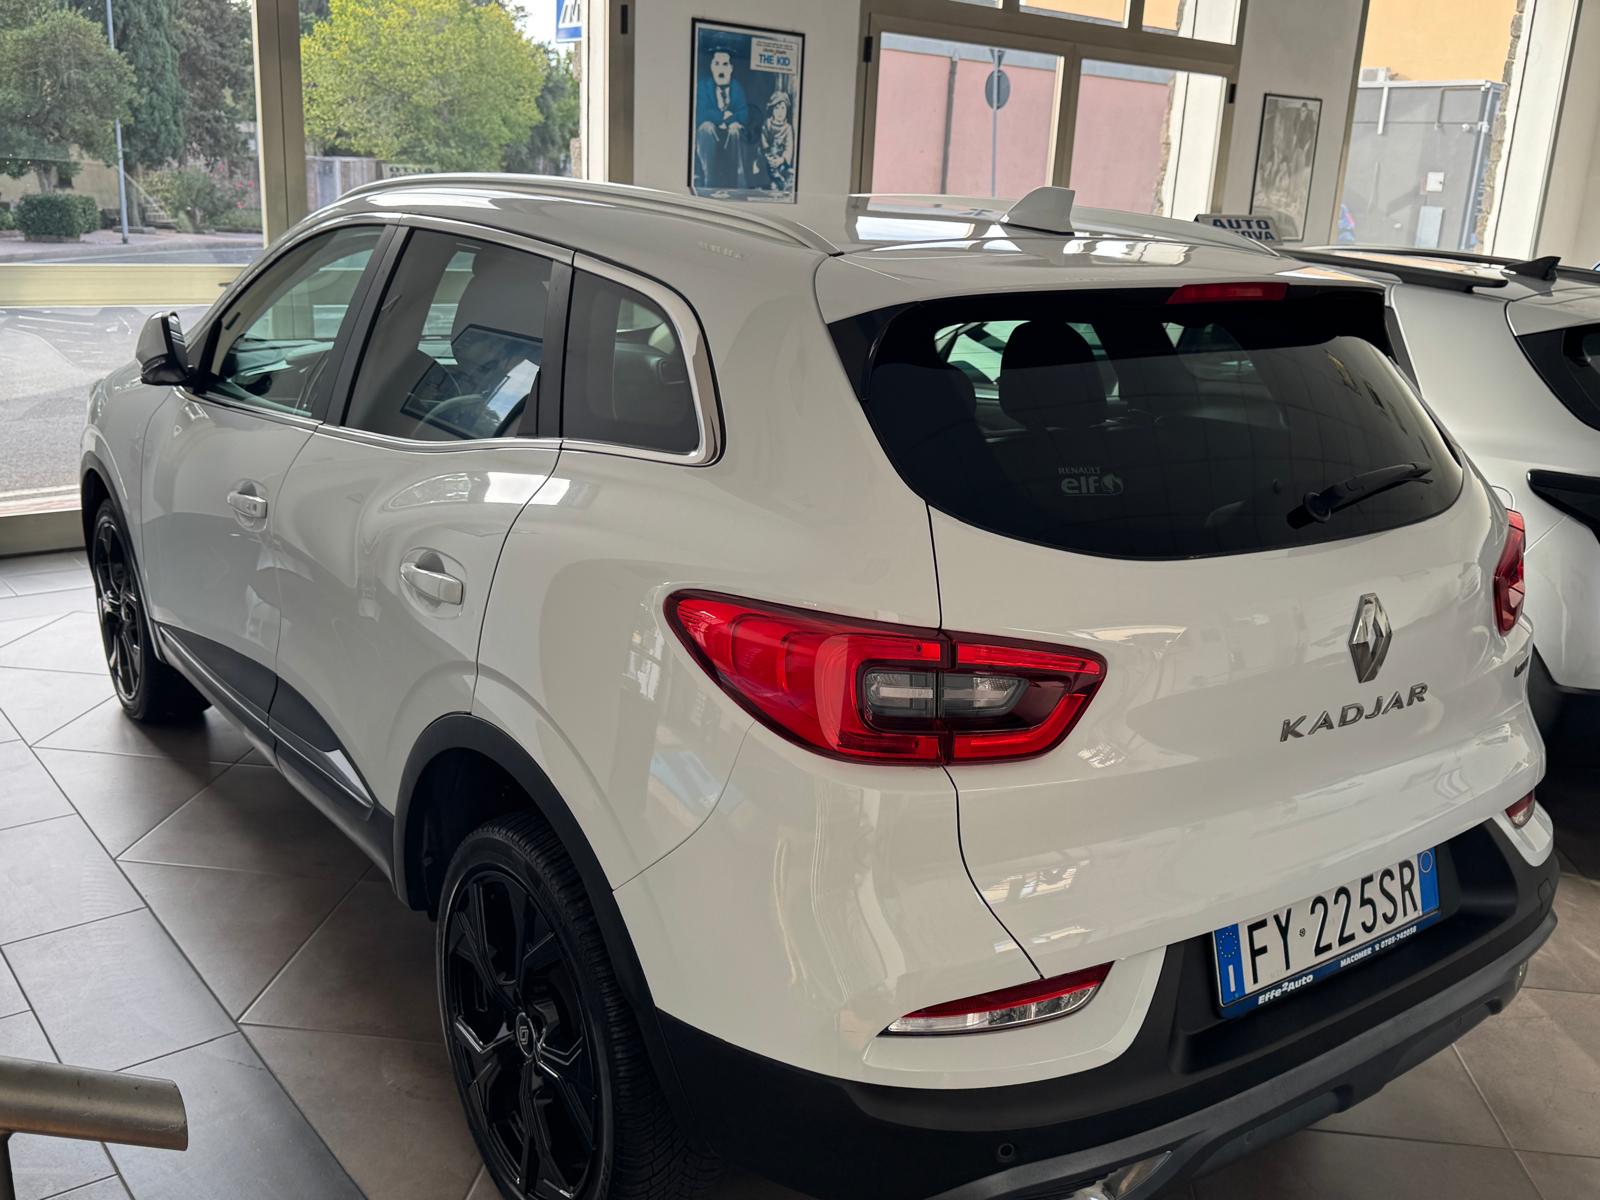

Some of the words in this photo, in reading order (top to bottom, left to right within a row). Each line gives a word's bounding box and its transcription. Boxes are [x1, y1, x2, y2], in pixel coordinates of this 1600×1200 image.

[759, 53, 774, 64] THE
[777, 56, 790, 66] KID
[1212, 219, 1270, 230] AUTO
[1234, 230, 1275, 241] OVA
[1061, 476, 1099, 494] elf
[1279, 682, 1428, 742] KADJAR
[1247, 907, 1292, 985] FY
[1309, 859, 1418, 957] 225SR
[1340, 947, 1372, 968] MACOMER
